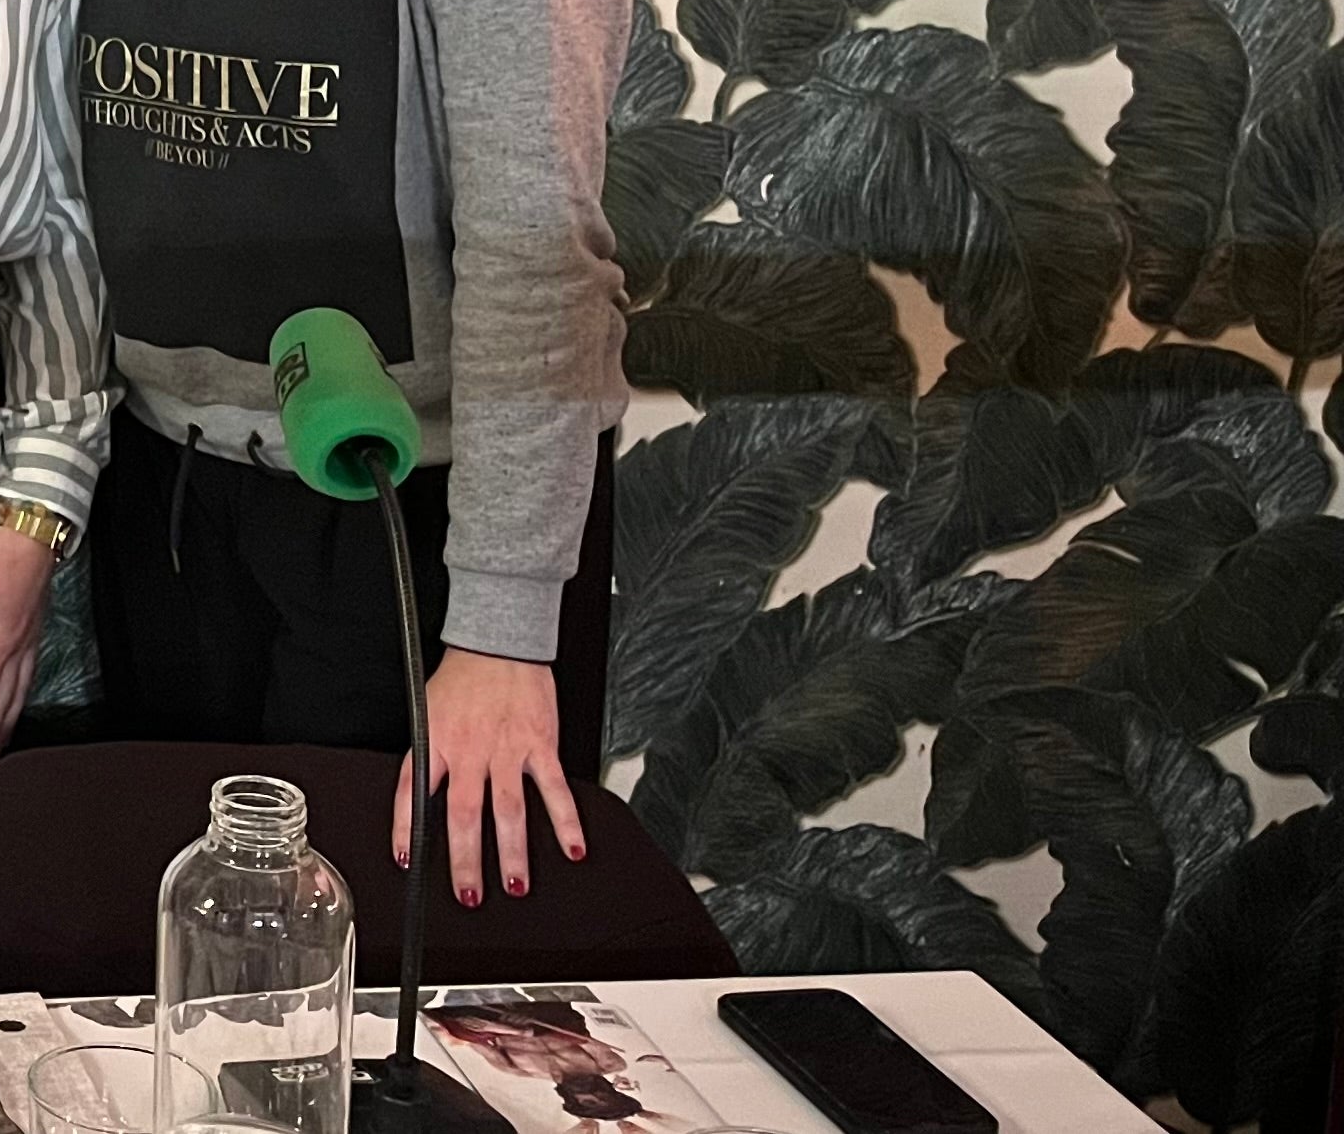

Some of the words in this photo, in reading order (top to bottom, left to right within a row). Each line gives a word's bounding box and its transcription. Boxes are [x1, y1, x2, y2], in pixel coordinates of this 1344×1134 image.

[79, 33, 340, 121] POSITIVE
[82, 97, 207, 144] THOUGHTS
[210, 116, 231, 147] &
[236, 121, 312, 155] ACTS
